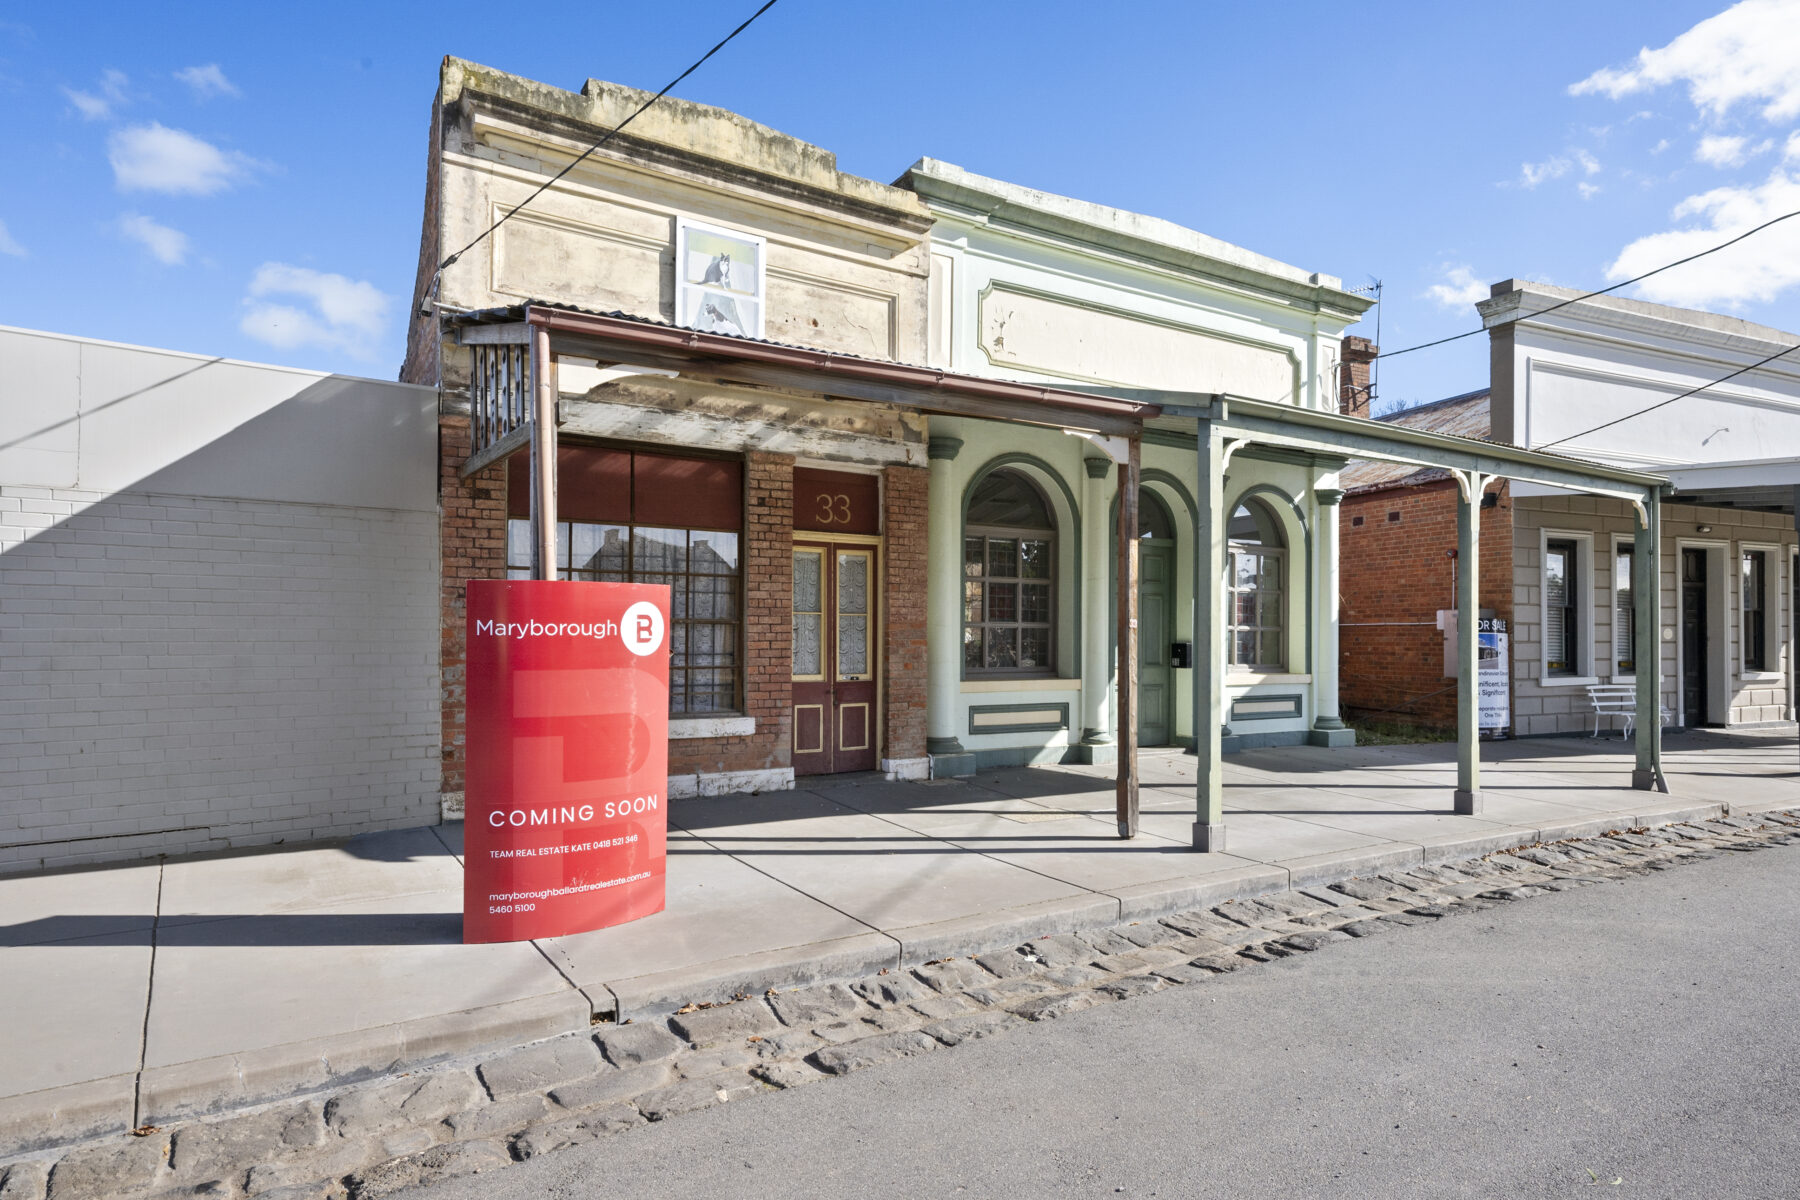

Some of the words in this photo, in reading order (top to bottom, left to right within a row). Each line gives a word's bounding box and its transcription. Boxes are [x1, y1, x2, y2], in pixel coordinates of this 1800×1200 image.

[815, 493, 851, 524] 33
[476, 618, 617, 639] Maryborough
[1478, 619, 1490, 630] OR
[1491, 618, 1506, 631] SALE
[488, 804, 594, 827] COMING
[604, 794, 658, 818] SOON
[489, 850, 514, 858] TEAM
[515, 848, 537, 857] REAL
[538, 845, 570, 856] ESTATE
[571, 842, 592, 852] KATE
[593, 839, 611, 849] 0418
[612, 837, 624, 846] 521
[625, 834, 638, 843] 346
[489, 870, 651, 902] maryboroughballaratrealestate.com.au
[489, 905, 513, 914] 5460
[514, 903, 536, 913] 5100
